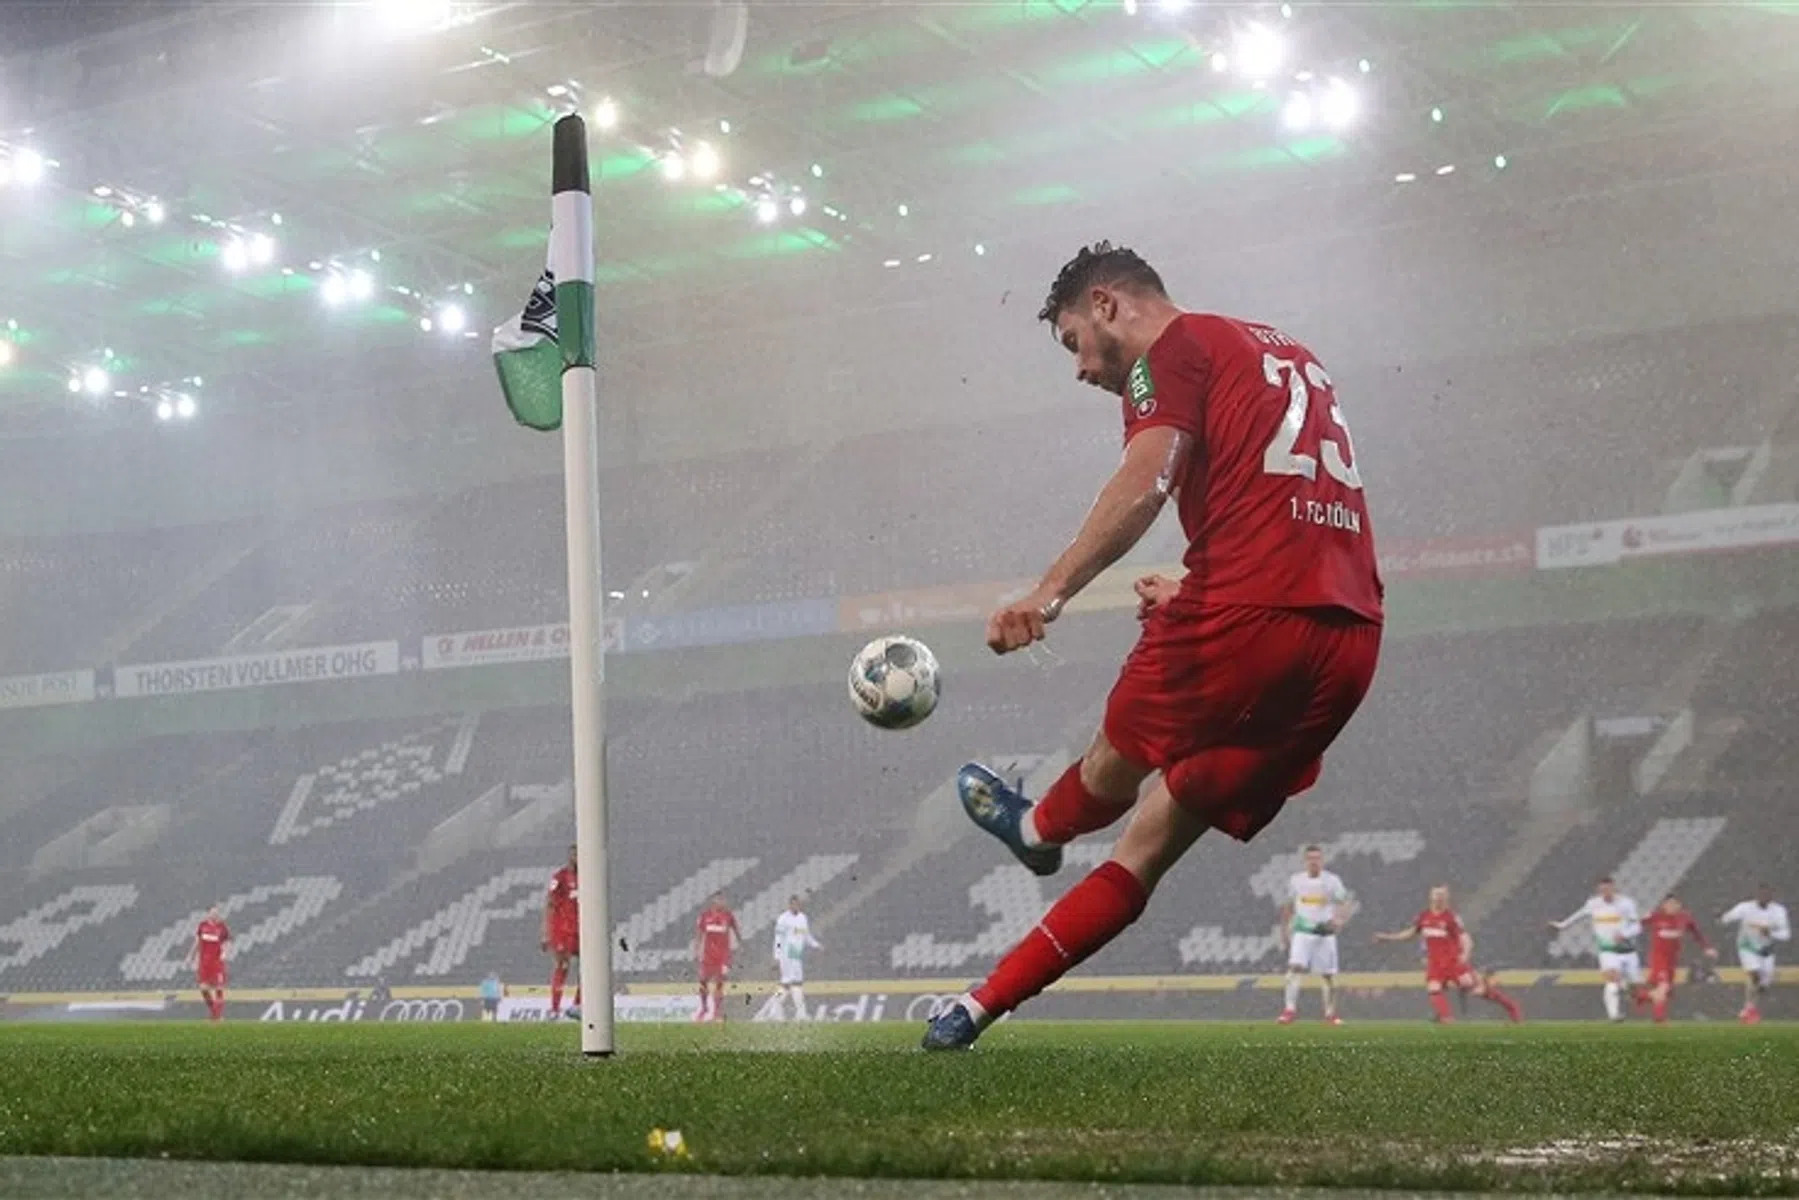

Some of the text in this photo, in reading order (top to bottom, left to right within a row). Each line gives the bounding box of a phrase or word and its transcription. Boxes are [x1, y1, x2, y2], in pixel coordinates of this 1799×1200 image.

[1263, 353, 1363, 489] 23
[1290, 496, 1303, 520] 1.
[1306, 500, 1325, 525] FC
[135, 649, 377, 693] THORSTEN VOLLMER OHG
[260, 998, 368, 1022] Audi
